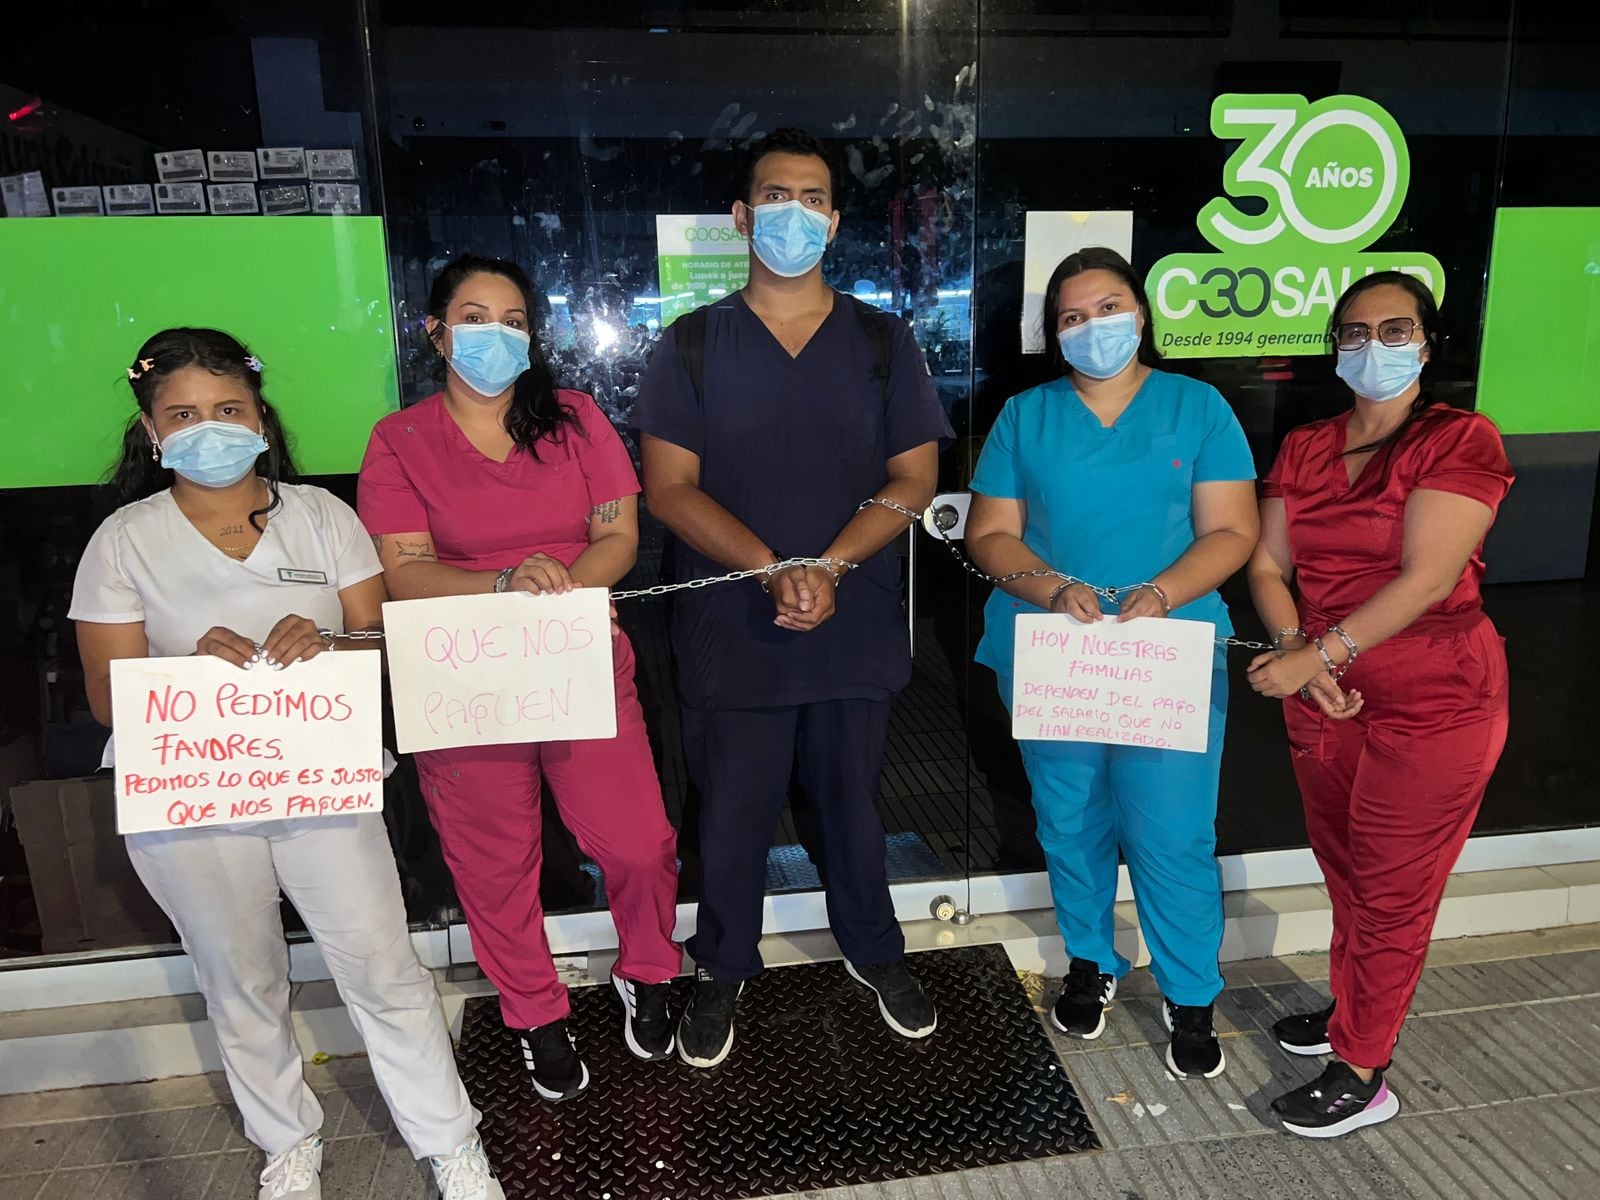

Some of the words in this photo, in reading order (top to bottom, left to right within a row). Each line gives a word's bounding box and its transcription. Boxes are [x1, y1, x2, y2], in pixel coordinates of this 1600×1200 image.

[1210, 109, 1398, 245] 30
[1305, 161, 1374, 188] AÑOS
[681, 261, 719, 269] HORARIO
[720, 261, 732, 269] DE
[689, 272, 719, 280] Lunes
[1162, 332, 1212, 347] Desde
[1216, 332, 1254, 345] 1994
[424, 626, 507, 670] QUE
[523, 616, 594, 658] NOS
[1031, 630, 1070, 653] HOY
[1081, 634, 1179, 661] NUESTRAS
[1069, 659, 1153, 683] FAMILIAS
[145, 685, 197, 723] NO
[216, 683, 352, 722] PEDIMOS
[1023, 682, 1099, 701] DEPENDEN
[1106, 691, 1144, 708] DEL
[1015, 704, 1043, 718] DEL
[1052, 706, 1110, 723] SALARIO
[1118, 714, 1153, 730] QUE
[1160, 718, 1183, 731] NO
[1039, 723, 1070, 738] HAN
[124, 772, 210, 796] PEDIMOS
[217, 771, 242, 787] LO
[248, 770, 290, 790] QUE
[297, 769, 323, 784] ES
[331, 767, 382, 785] JUSTO
[167, 800, 216, 825] QUE
[230, 798, 272, 817] NOS
